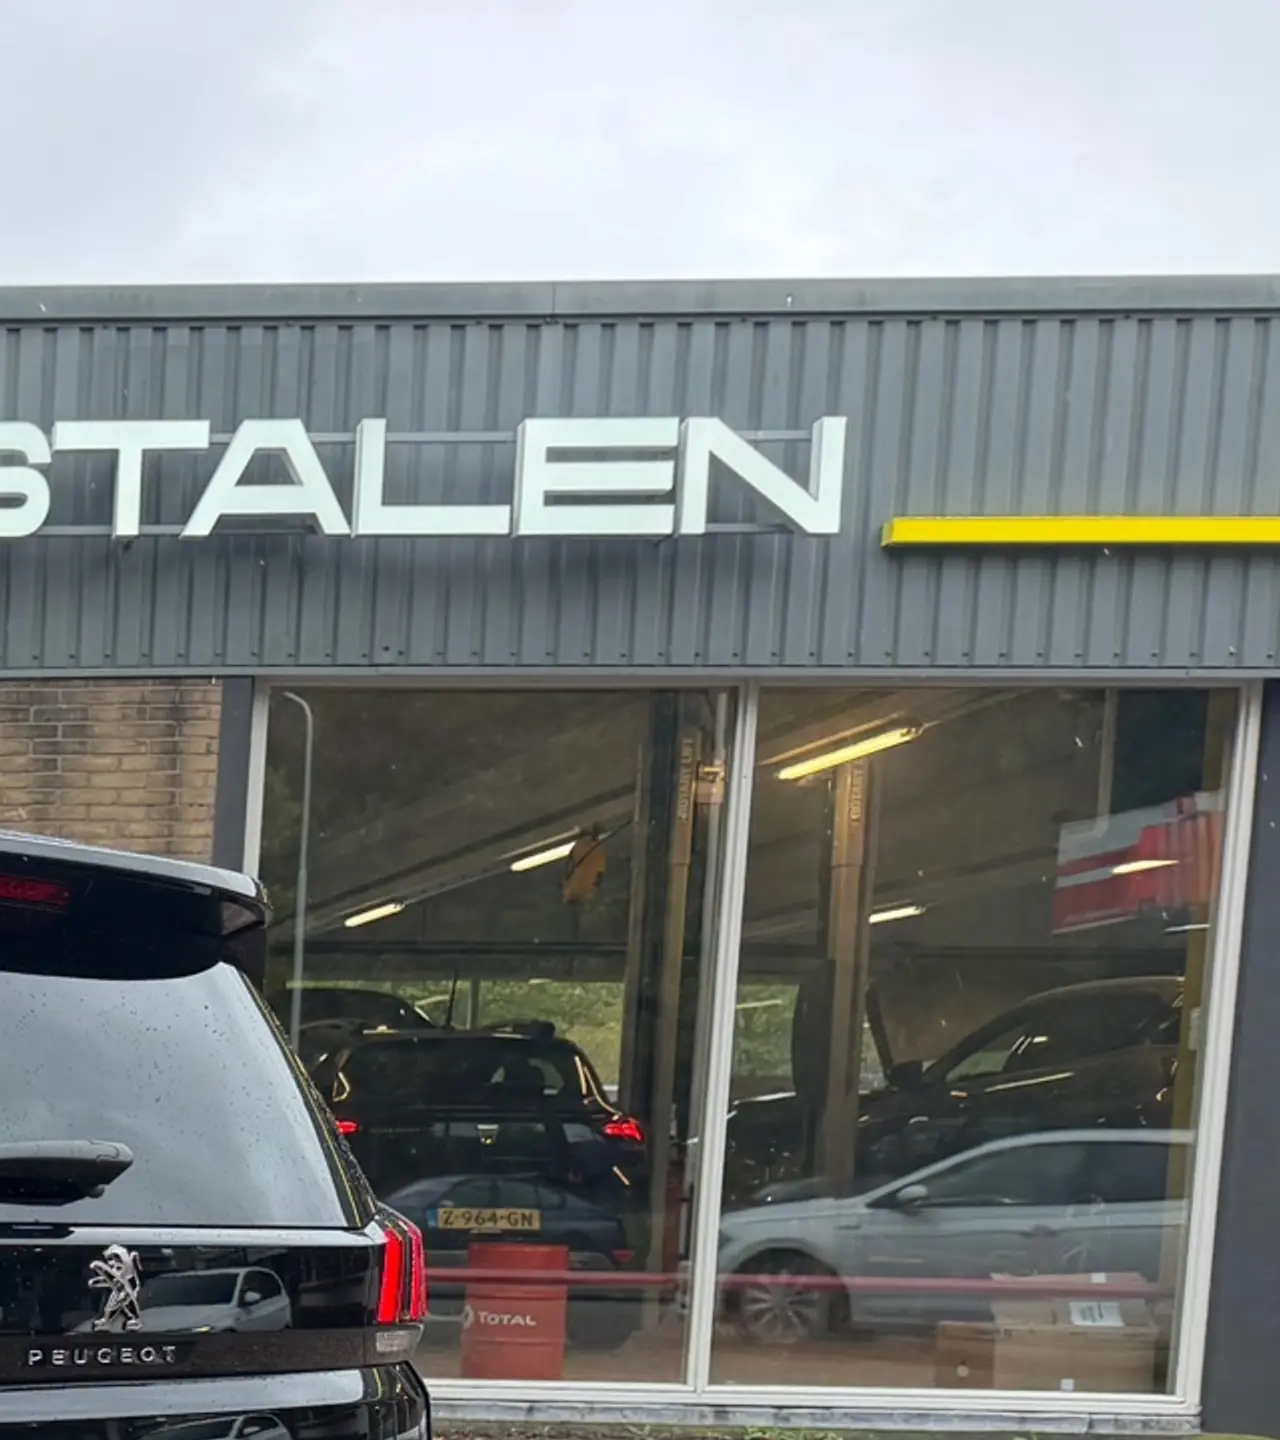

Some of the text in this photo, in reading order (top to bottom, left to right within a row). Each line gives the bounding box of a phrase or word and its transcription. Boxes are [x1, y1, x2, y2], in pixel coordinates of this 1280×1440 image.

[442, 1209, 536, 1228] Z-964-GN
[477, 1310, 538, 1326] TOTAL
[28, 1346, 177, 1365] PEUGEOT
